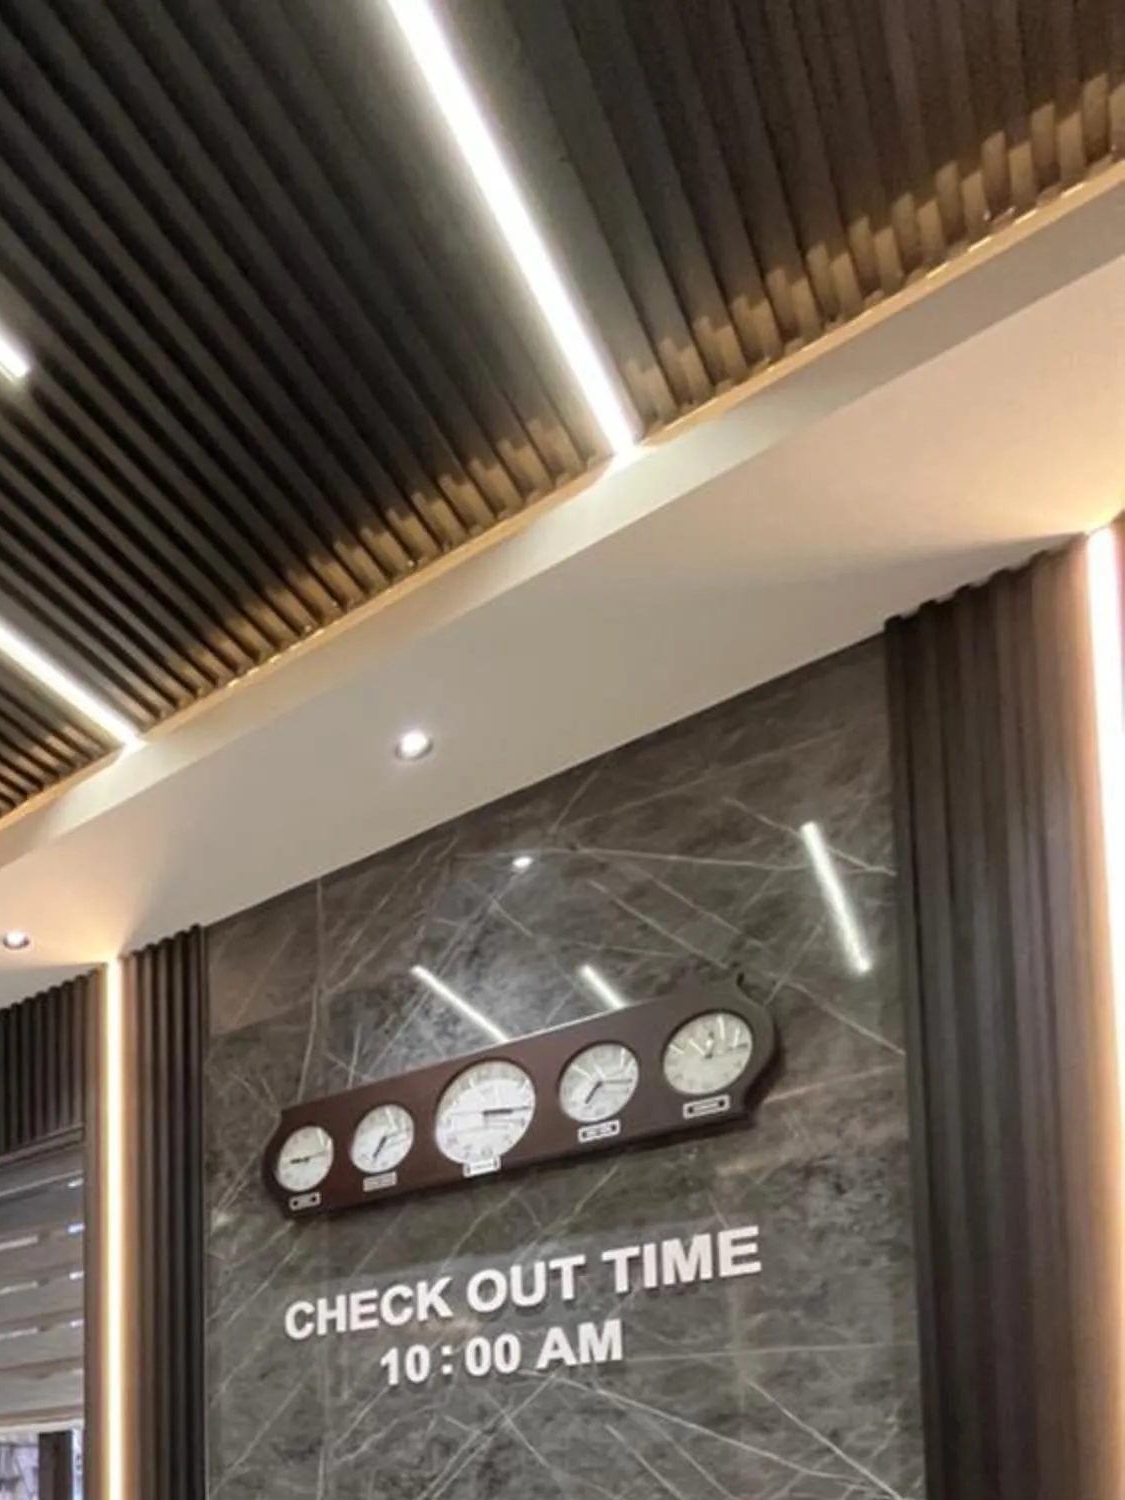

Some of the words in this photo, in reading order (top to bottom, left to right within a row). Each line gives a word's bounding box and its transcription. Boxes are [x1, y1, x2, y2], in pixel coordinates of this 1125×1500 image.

[284, 1275, 455, 1340] CHECK
[466, 1254, 587, 1313] OUT
[601, 1226, 762, 1293] TIME
[535, 1318, 623, 1370] AM
